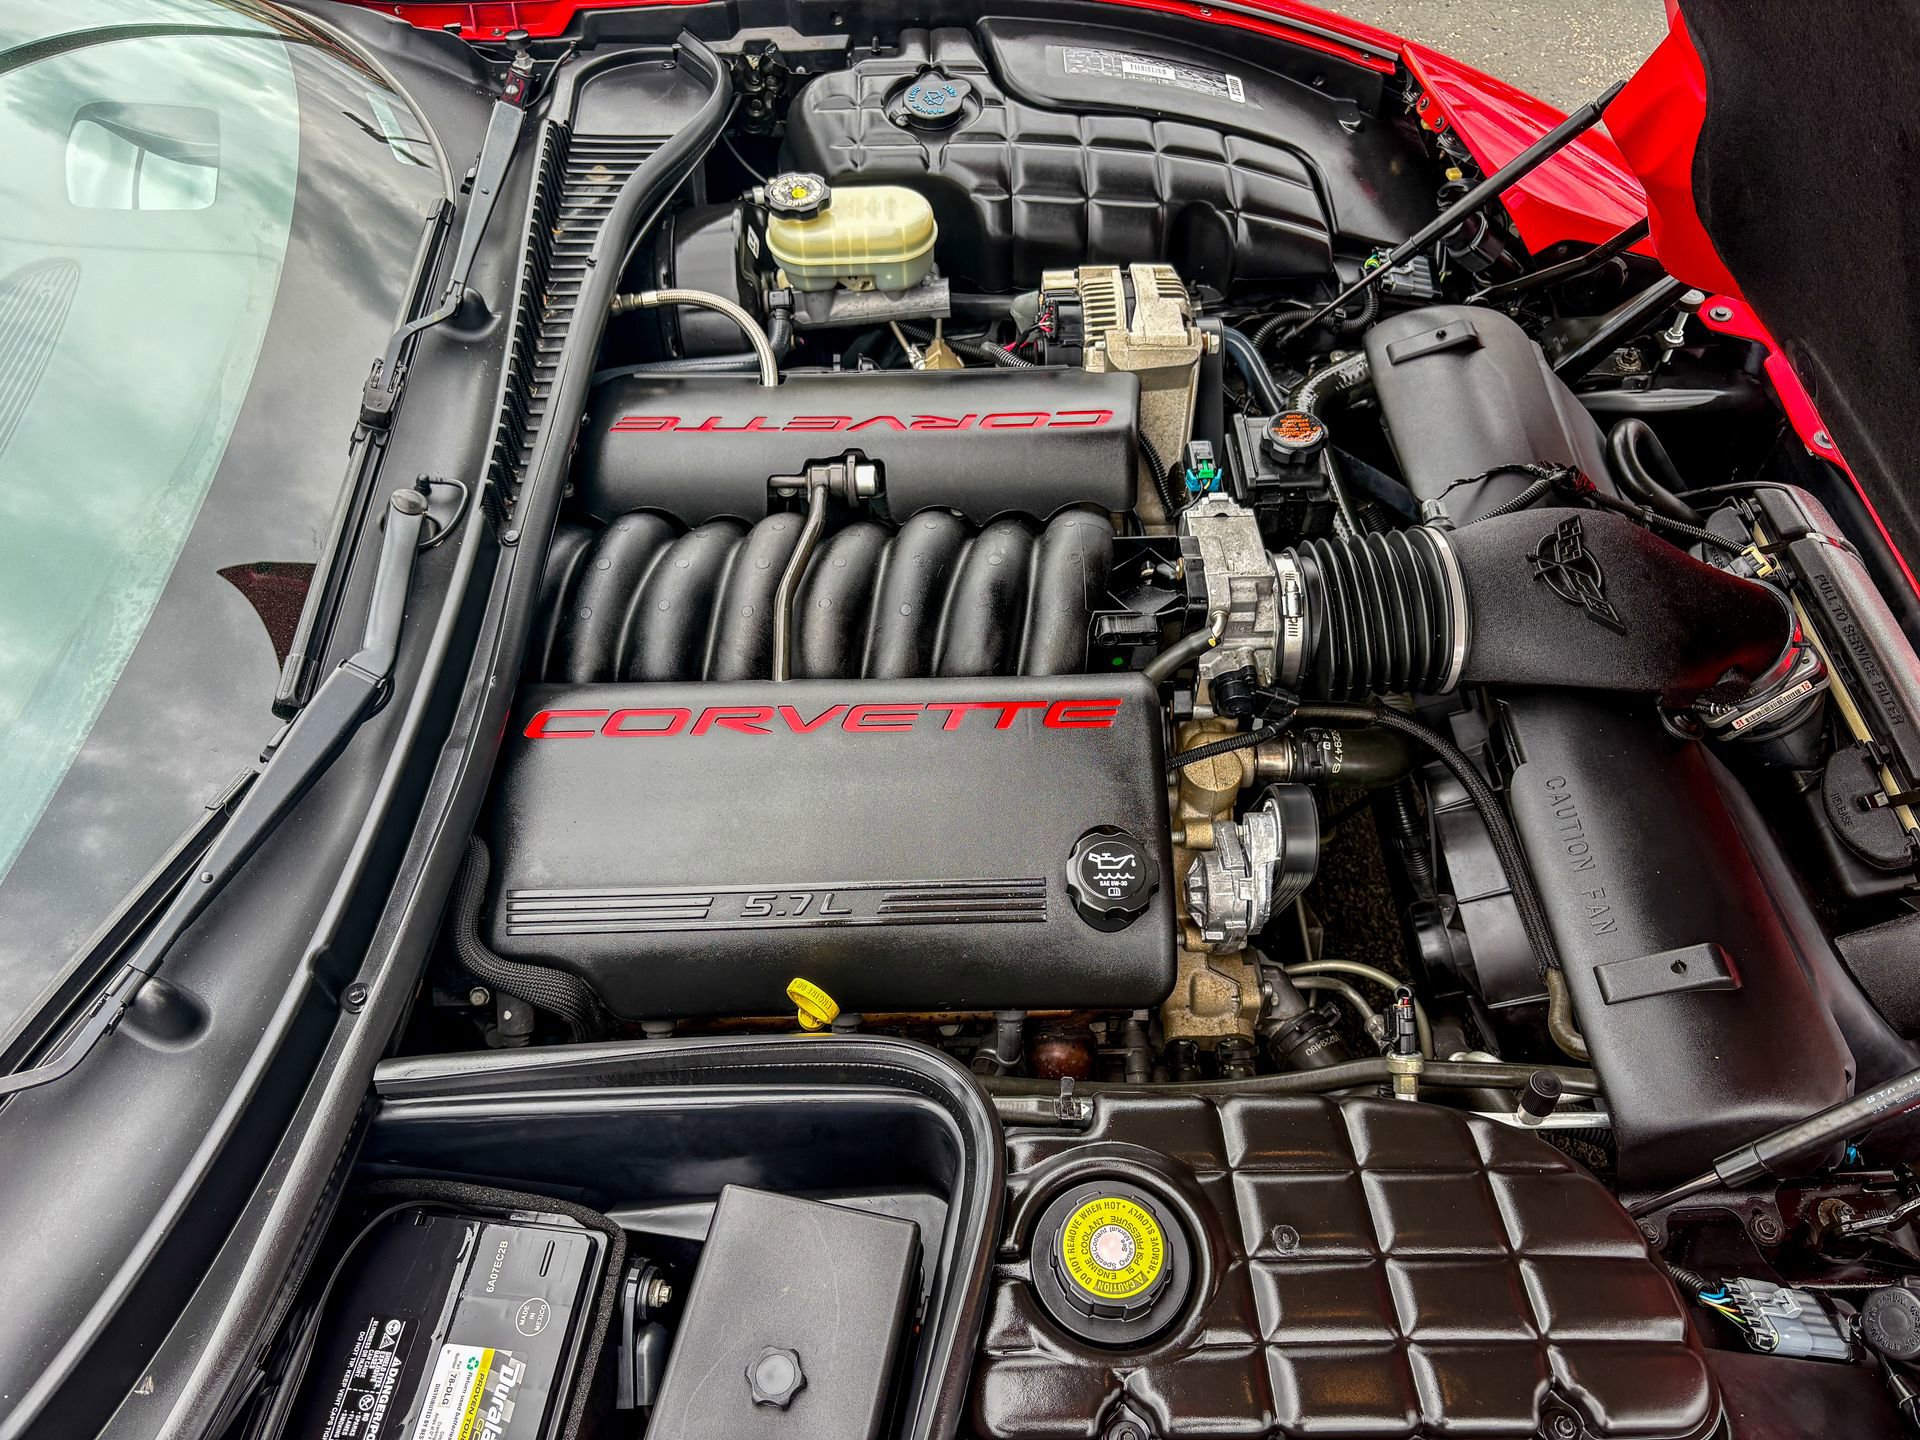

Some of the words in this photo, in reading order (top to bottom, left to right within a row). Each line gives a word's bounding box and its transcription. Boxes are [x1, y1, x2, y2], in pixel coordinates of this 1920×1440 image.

[608, 408, 1116, 433] CORVETTE
[1814, 573, 1837, 605] PULL
[1832, 604, 1849, 622] TO
[1843, 622, 1880, 679] SERVICE
[1871, 678, 1905, 725] FILTER
[522, 698, 1123, 740] CORVETTE
[1544, 775, 1596, 873] CAUTION
[1581, 887, 1618, 936] FAN
[740, 893, 852, 917] 5.7L
[1866, 1076, 1920, 1104] STAIL
[1079, 1202, 1102, 1220] WHEN
[1104, 1201, 1121, 1210] HOT
[1110, 1215, 1144, 1250] PRESSURE
[1127, 1207, 1155, 1236] SLOWLY
[1067, 1219, 1082, 1254] REMOVE
[1081, 1216, 1104, 1255] COOLANT
[1091, 1226, 1108, 1253] Coolant
[1109, 1226, 1132, 1243] Manual
[1120, 1239, 1128, 1252] See
[1093, 1252, 1117, 1270] Special
[1133, 1251, 1144, 1267] PSI
[1148, 1236, 1160, 1271] REMOVE
[485, 1240, 509, 1293] 6A07EC2B
[1069, 1257, 1081, 1274] NOT
[1084, 1257, 1117, 1280] ENGINE
[1125, 1265, 1135, 1275] 15
[1080, 1272, 1092, 1285] DO
[1097, 1280, 1136, 1292] CAUTION
[519, 1304, 530, 1326] MADE
[529, 1312, 536, 1320] IN
[534, 1304, 547, 1332] MEXICO
[357, 1331, 366, 1342] DO
[364, 1320, 379, 1349] BLINDNESS
[351, 1341, 361, 1358] NOT
[341, 1369, 352, 1388] KEEP
[441, 1373, 458, 1405] 78-DLG
[461, 1371, 473, 1394] Return
[333, 1388, 345, 1407] VENT
[426, 1383, 441, 1419] DISTRIBUTED
[456, 1394, 466, 1413] used
[468, 1373, 485, 1415] PROVEN
[326, 1407, 338, 1427] CAPS
[422, 1419, 429, 1427] BY
